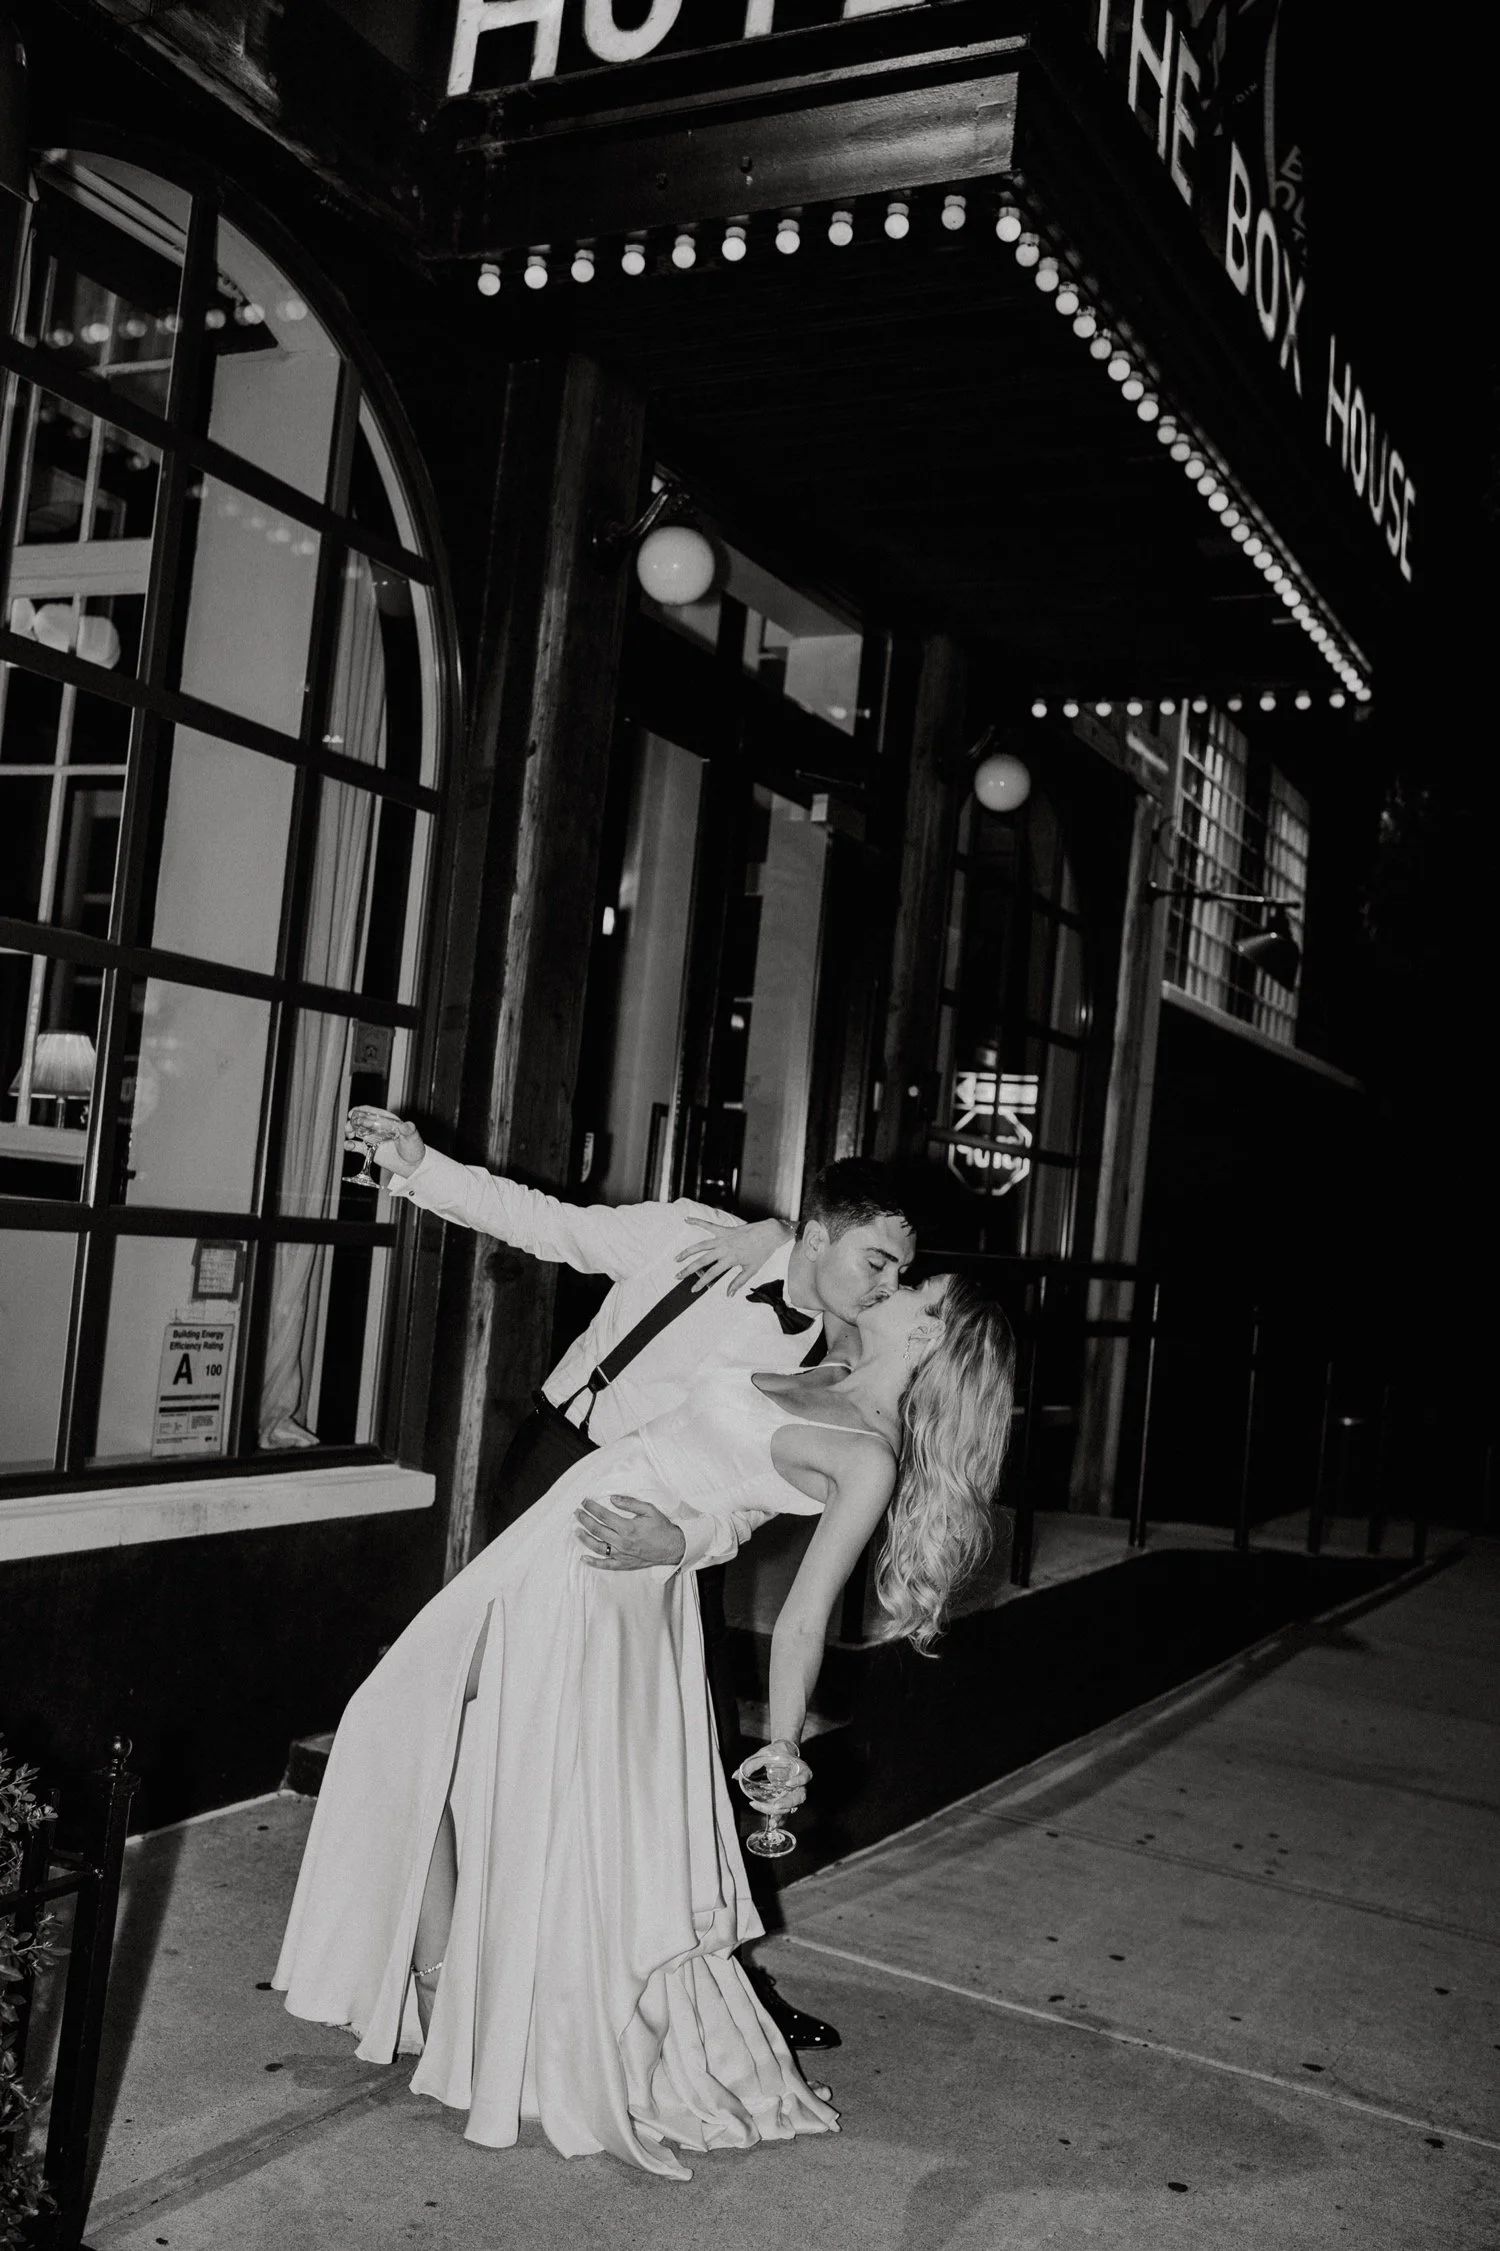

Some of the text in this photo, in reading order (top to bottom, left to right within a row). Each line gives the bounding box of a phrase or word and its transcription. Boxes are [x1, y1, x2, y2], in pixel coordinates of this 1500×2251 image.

[1225, 140, 1306, 399] BOX
[1325, 333, 1416, 584] HOUSE
[173, 1330, 224, 1340] Building Energy
[169, 1342, 224, 1352] Efficiency Rating
[172, 1353, 223, 1385] A 100
